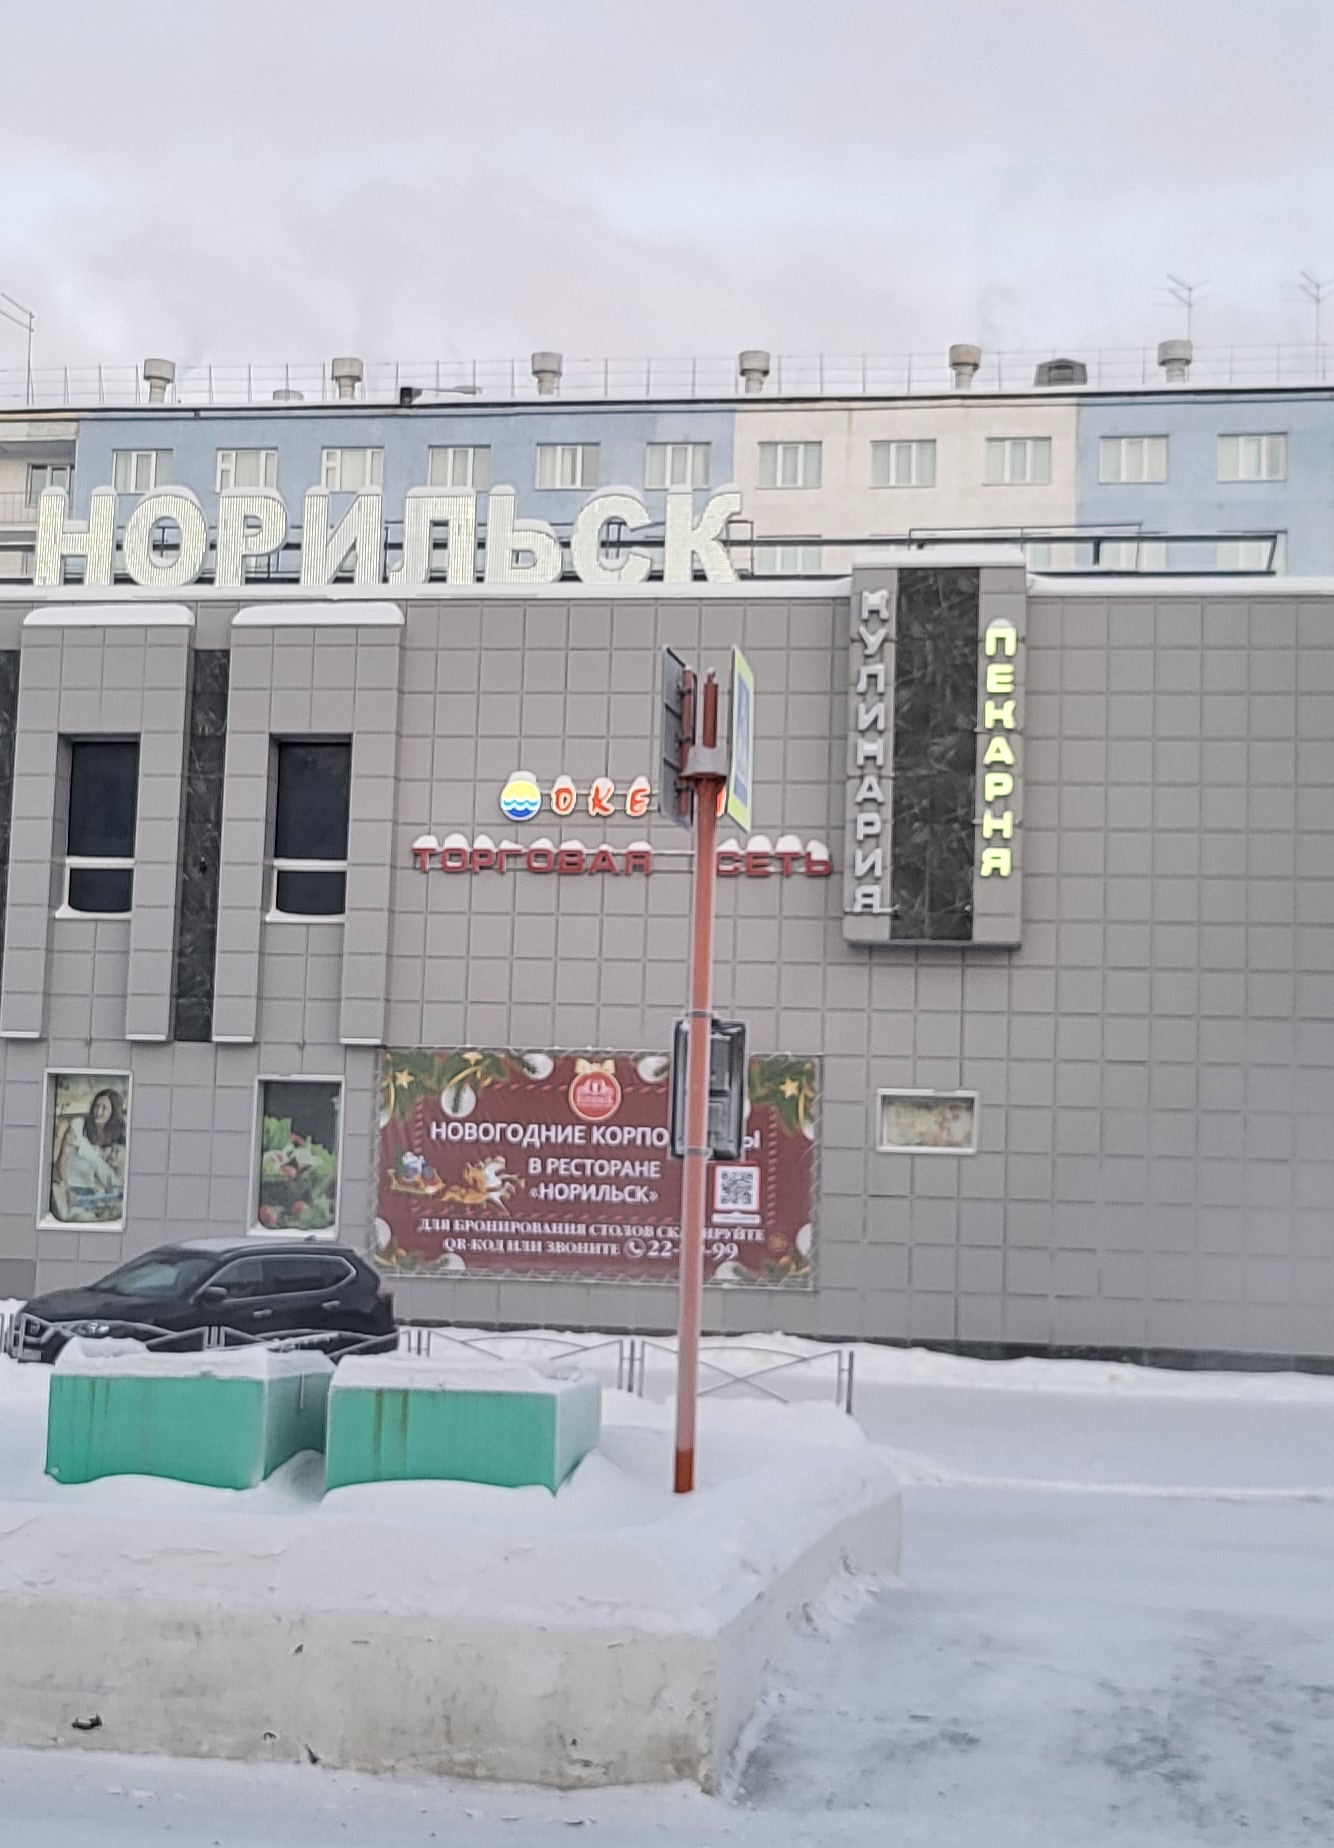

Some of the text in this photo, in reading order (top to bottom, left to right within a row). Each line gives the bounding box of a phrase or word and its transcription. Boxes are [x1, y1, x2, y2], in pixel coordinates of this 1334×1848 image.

[34, 490, 742, 588] НОРИЛЬСК
[853, 590, 890, 913] КУЛИНАРИЯ
[980, 624, 1017, 878] ПЕКАРНЯ
[412, 842, 833, 877] ТОРГОВАЯ СЕТЬ
[431, 1121, 760, 1150] НОВОГОДНИЕ КОРПОЫ
[528, 1157, 661, 1177] В РЕСТОРАНЕ
[529, 1183, 658, 1202] «НОРИЛЬСК»
[417, 1218, 765, 1241] ДЛЯ БРОНИРОВАНИЯ СТОЛОВ СКИРУЙТЕ
[443, 1237, 739, 1260] QR-КОД ИЛИ ЗВОНИТЕ 22--99
